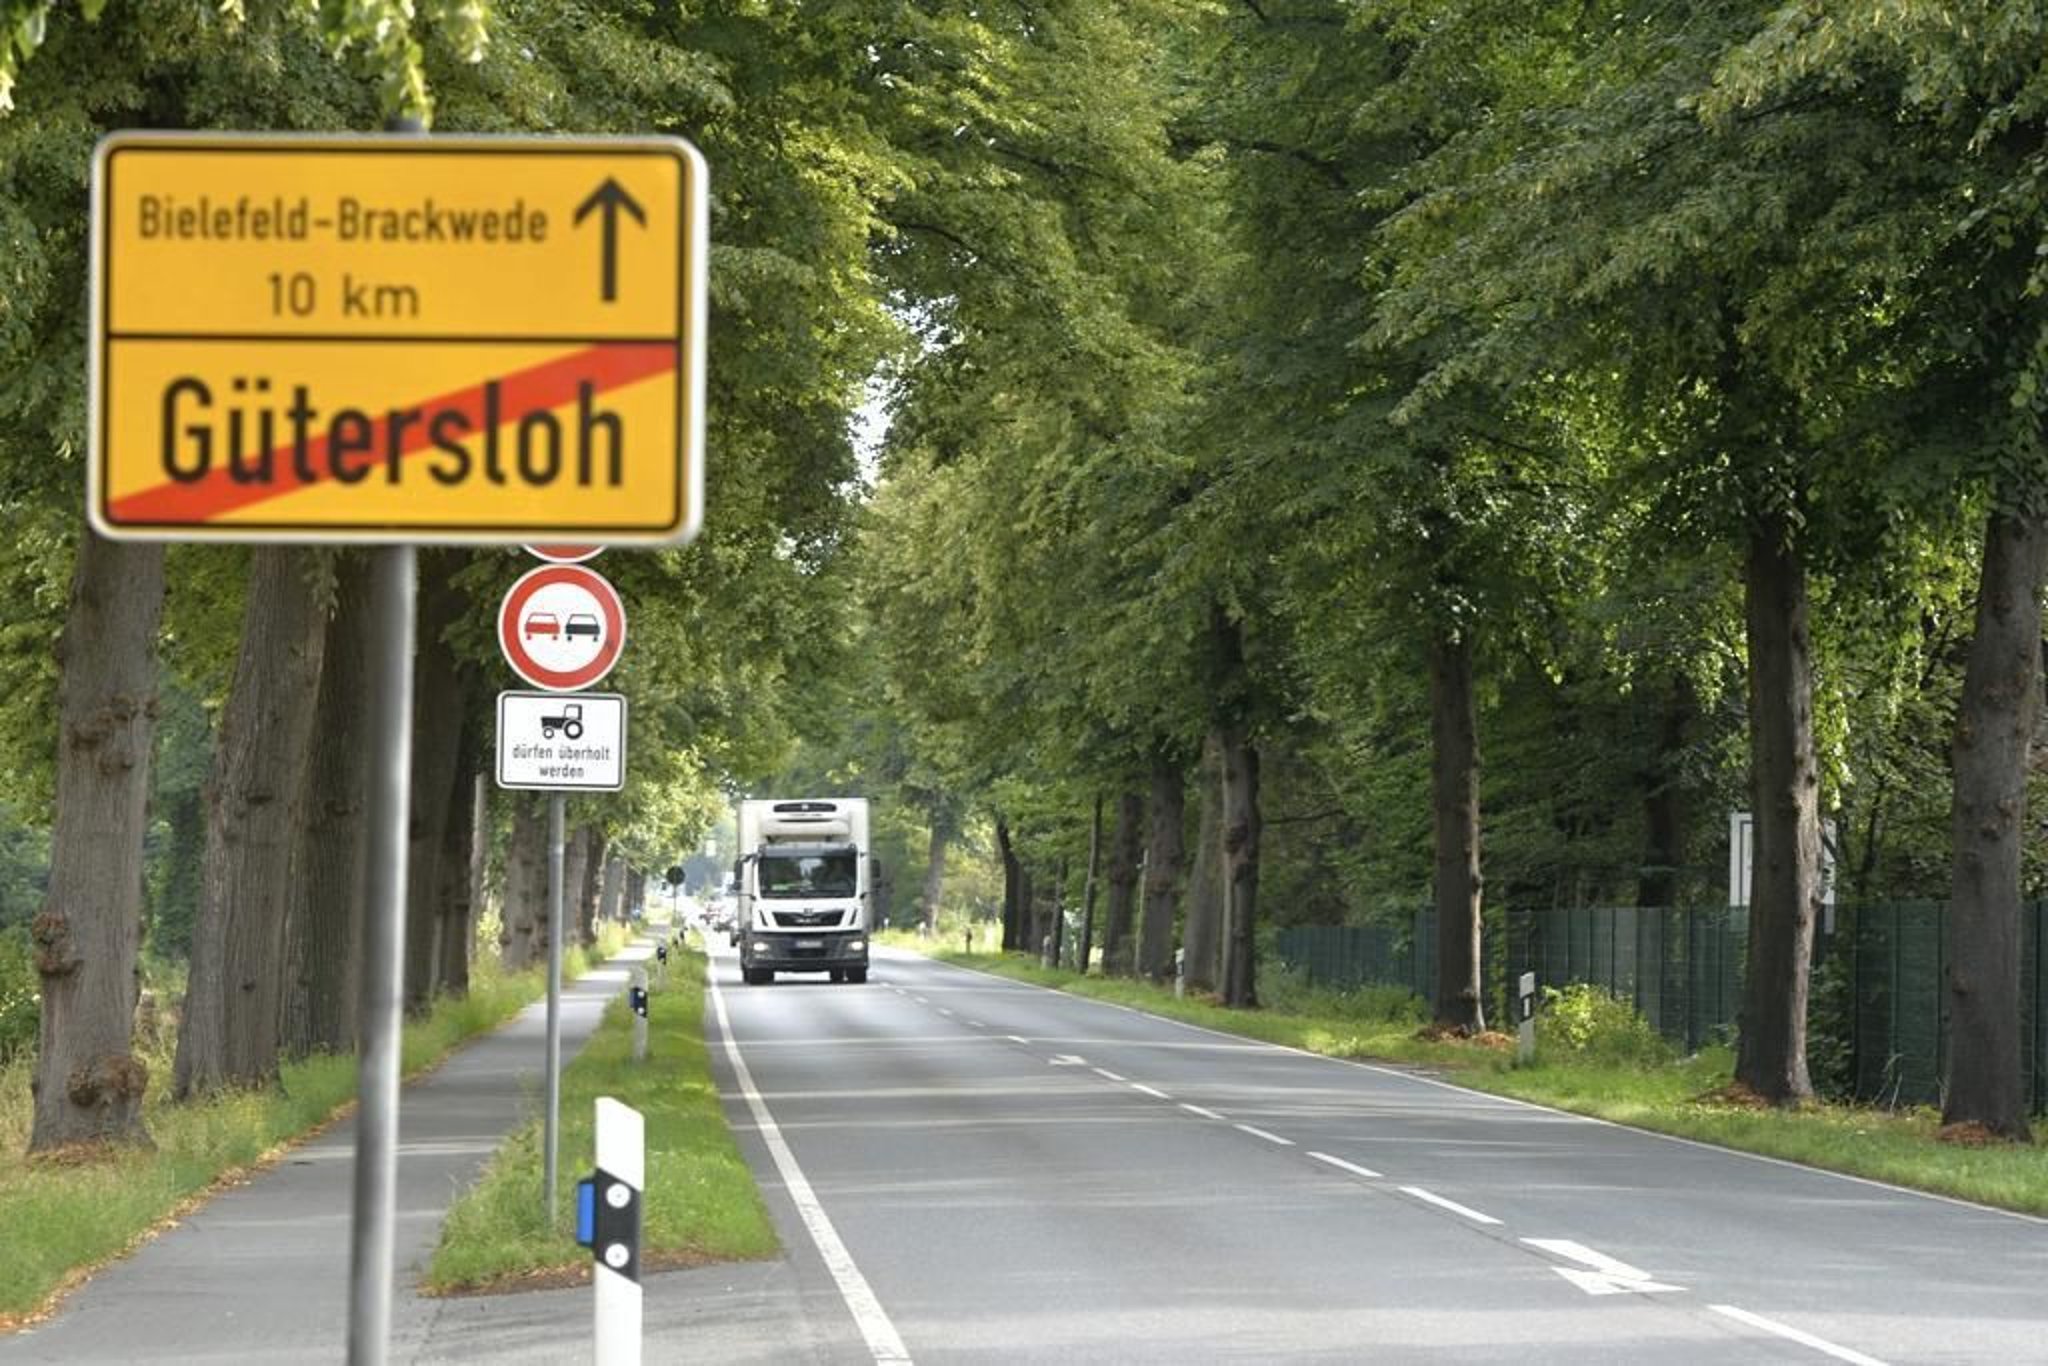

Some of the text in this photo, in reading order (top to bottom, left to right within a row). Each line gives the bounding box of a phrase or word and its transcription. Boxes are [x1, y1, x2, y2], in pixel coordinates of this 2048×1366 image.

[138, 194, 548, 242] Bielefeld-Brackwede
[267, 273, 420, 317] 10 km
[161, 376, 624, 487] Gütersloh
[512, 743, 610, 761] dürfen überholt
[539, 764, 584, 778] werden
